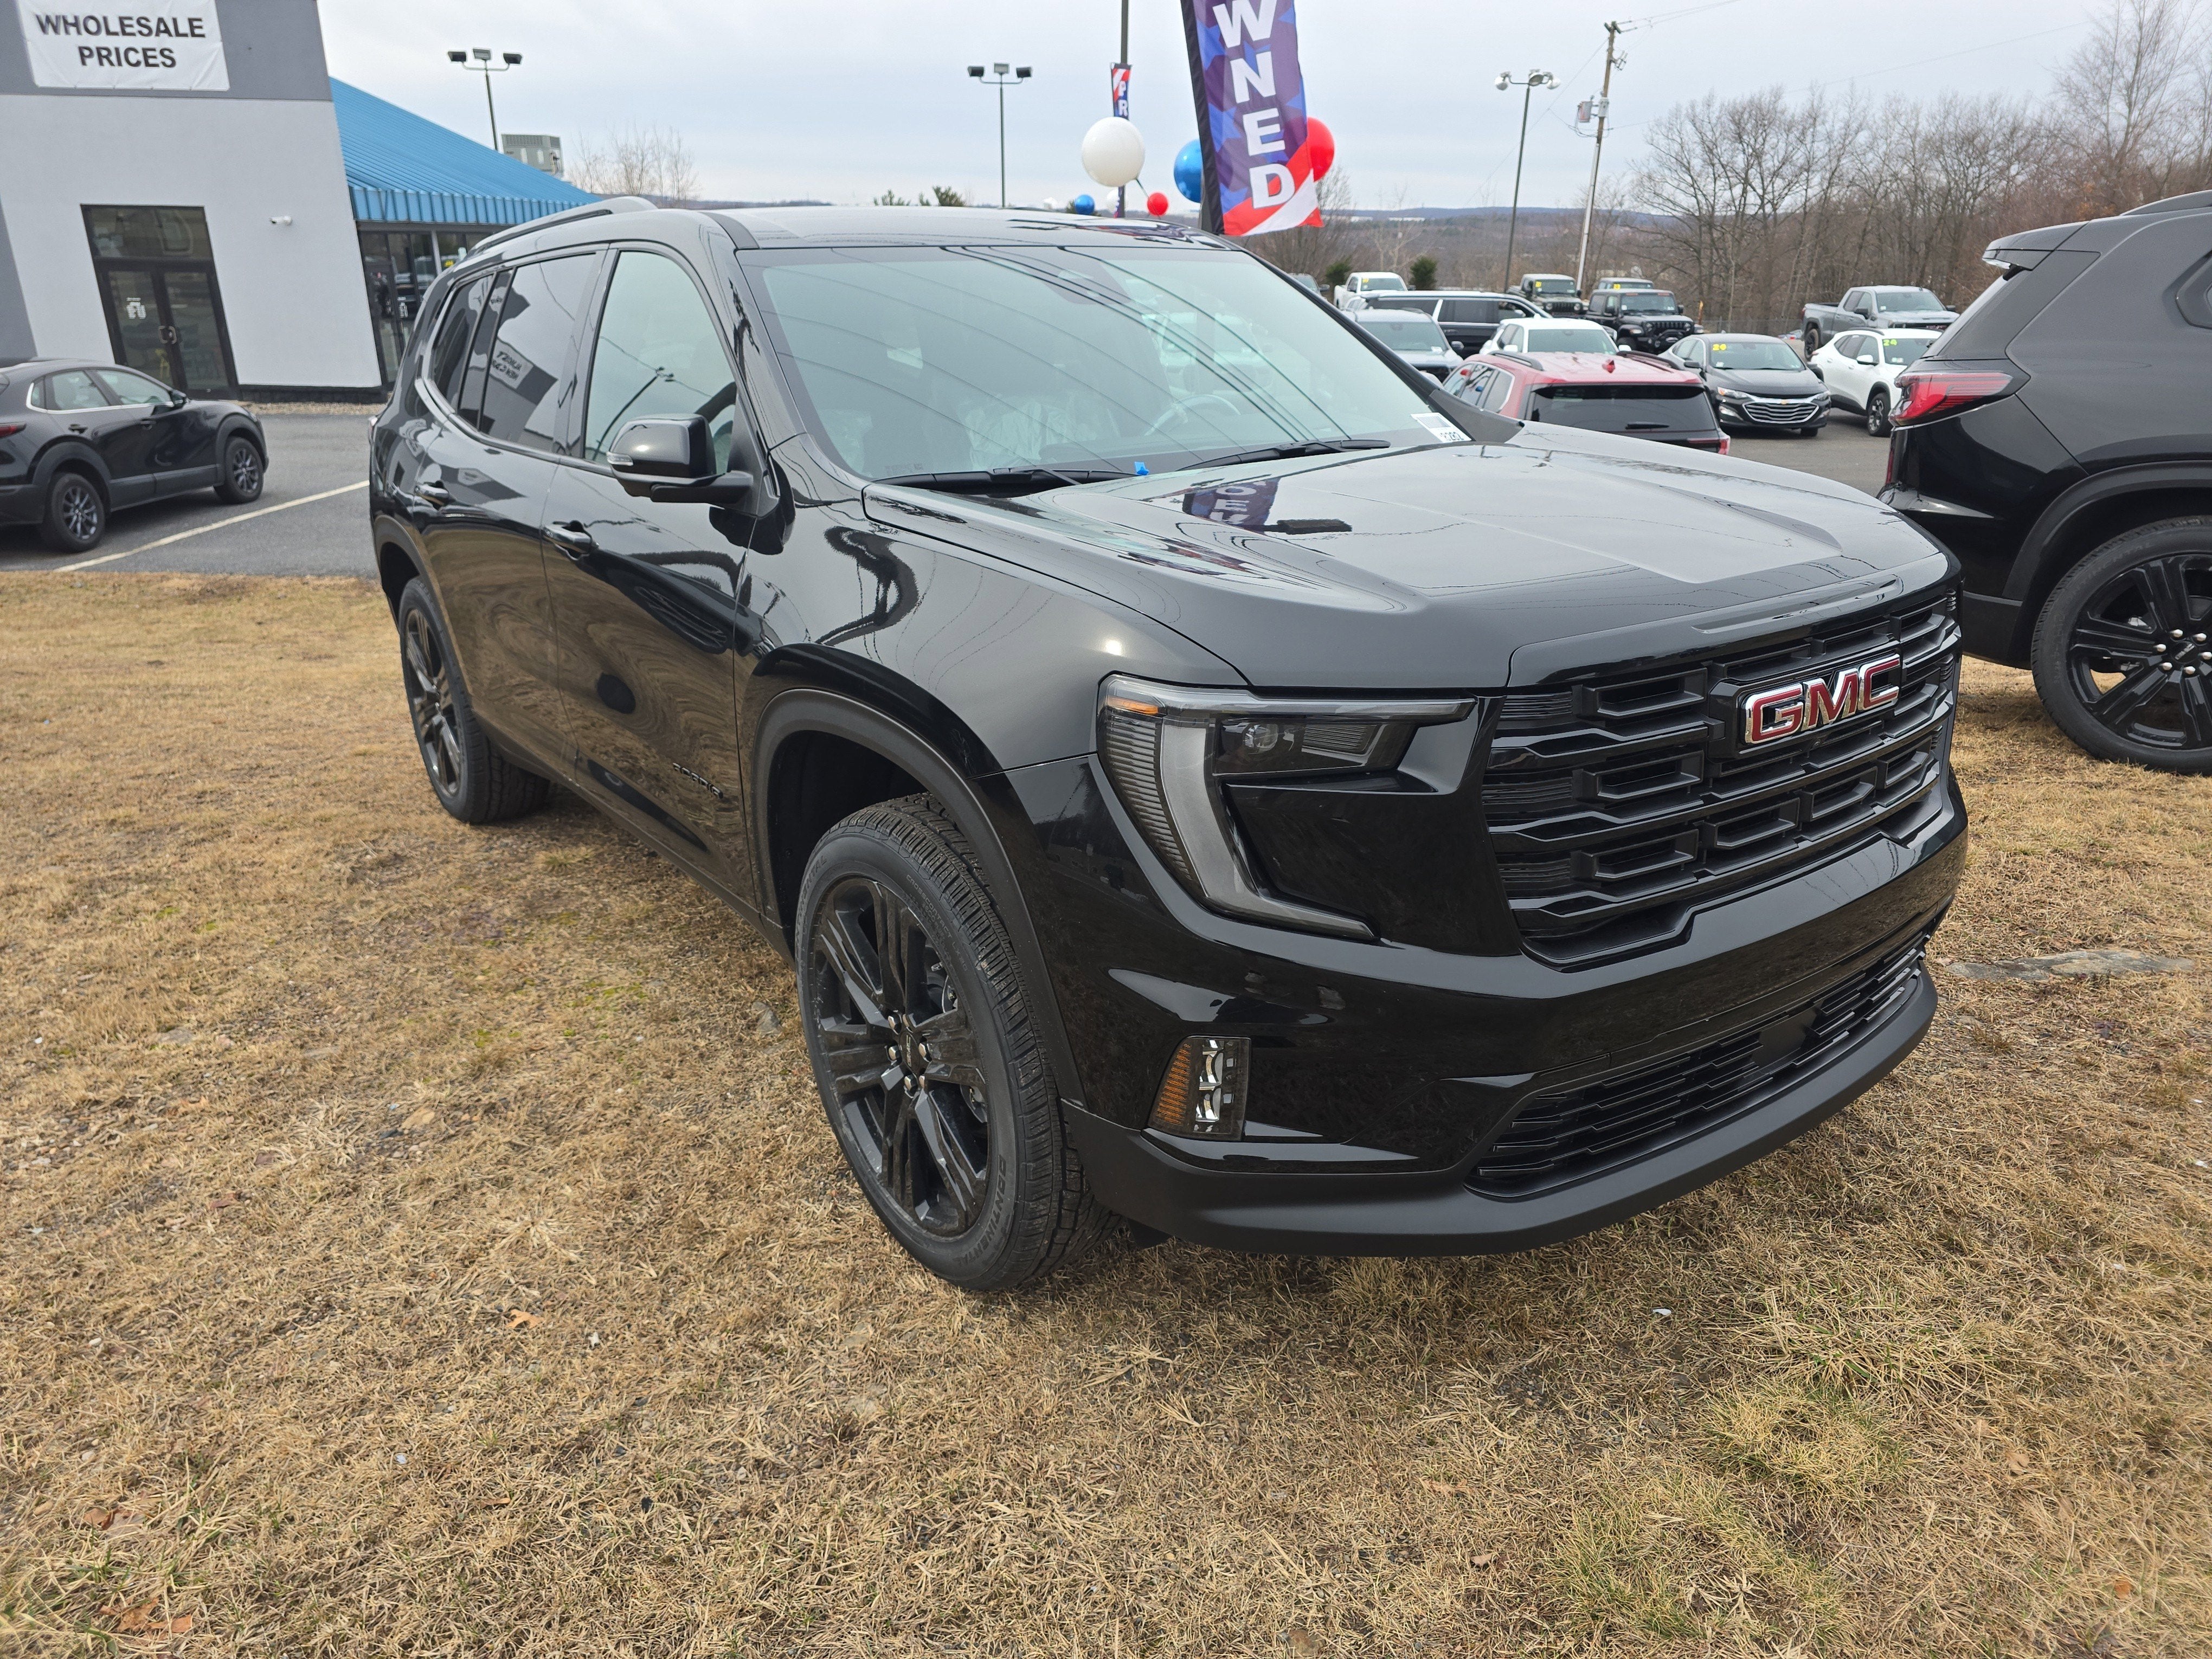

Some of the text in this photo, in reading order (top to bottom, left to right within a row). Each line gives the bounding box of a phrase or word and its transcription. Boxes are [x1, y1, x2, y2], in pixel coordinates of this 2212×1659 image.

[35, 14, 205, 38] WHOLESALE
[78, 46, 176, 68] PRICES
[1212, 0, 1295, 209] WNED
[1745, 654, 1900, 744] GMC
[953, 1154, 1007, 1267] CONTINENTAL
